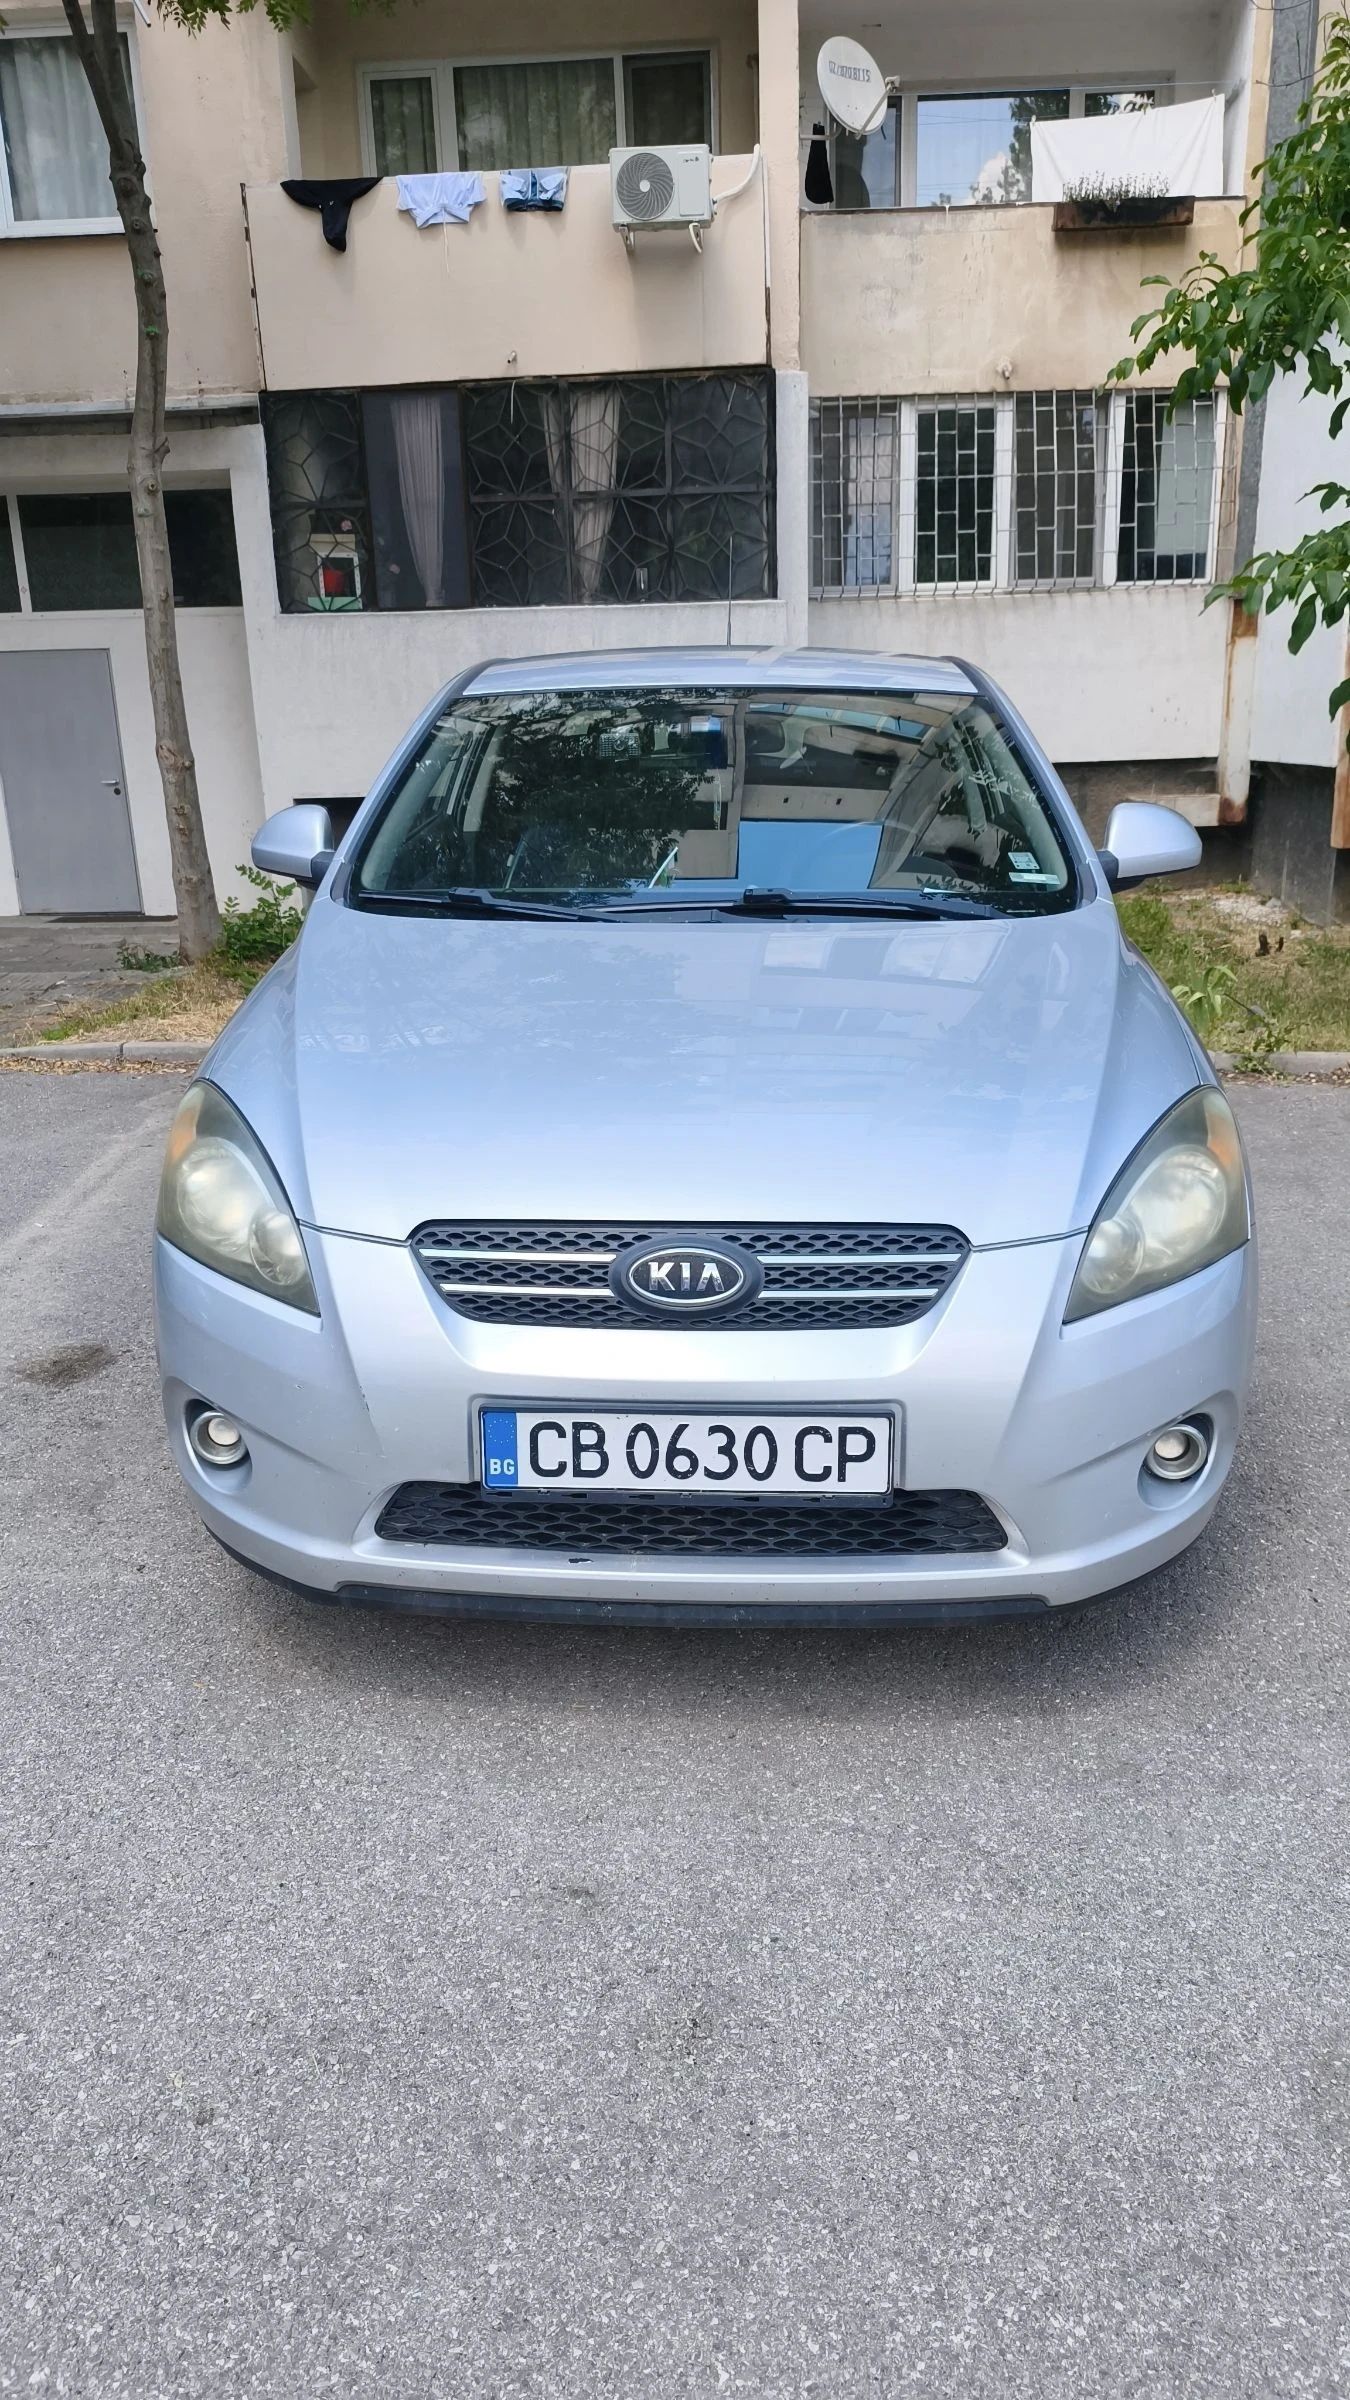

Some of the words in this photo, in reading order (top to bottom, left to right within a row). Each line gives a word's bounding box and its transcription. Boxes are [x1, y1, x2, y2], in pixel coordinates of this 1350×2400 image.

[647, 1261, 725, 1292] KIA
[489, 1458, 515, 1475] BG
[529, 1420, 610, 1478] CB
[625, 1422, 778, 1483] 0630
[794, 1425, 876, 1483] CP
